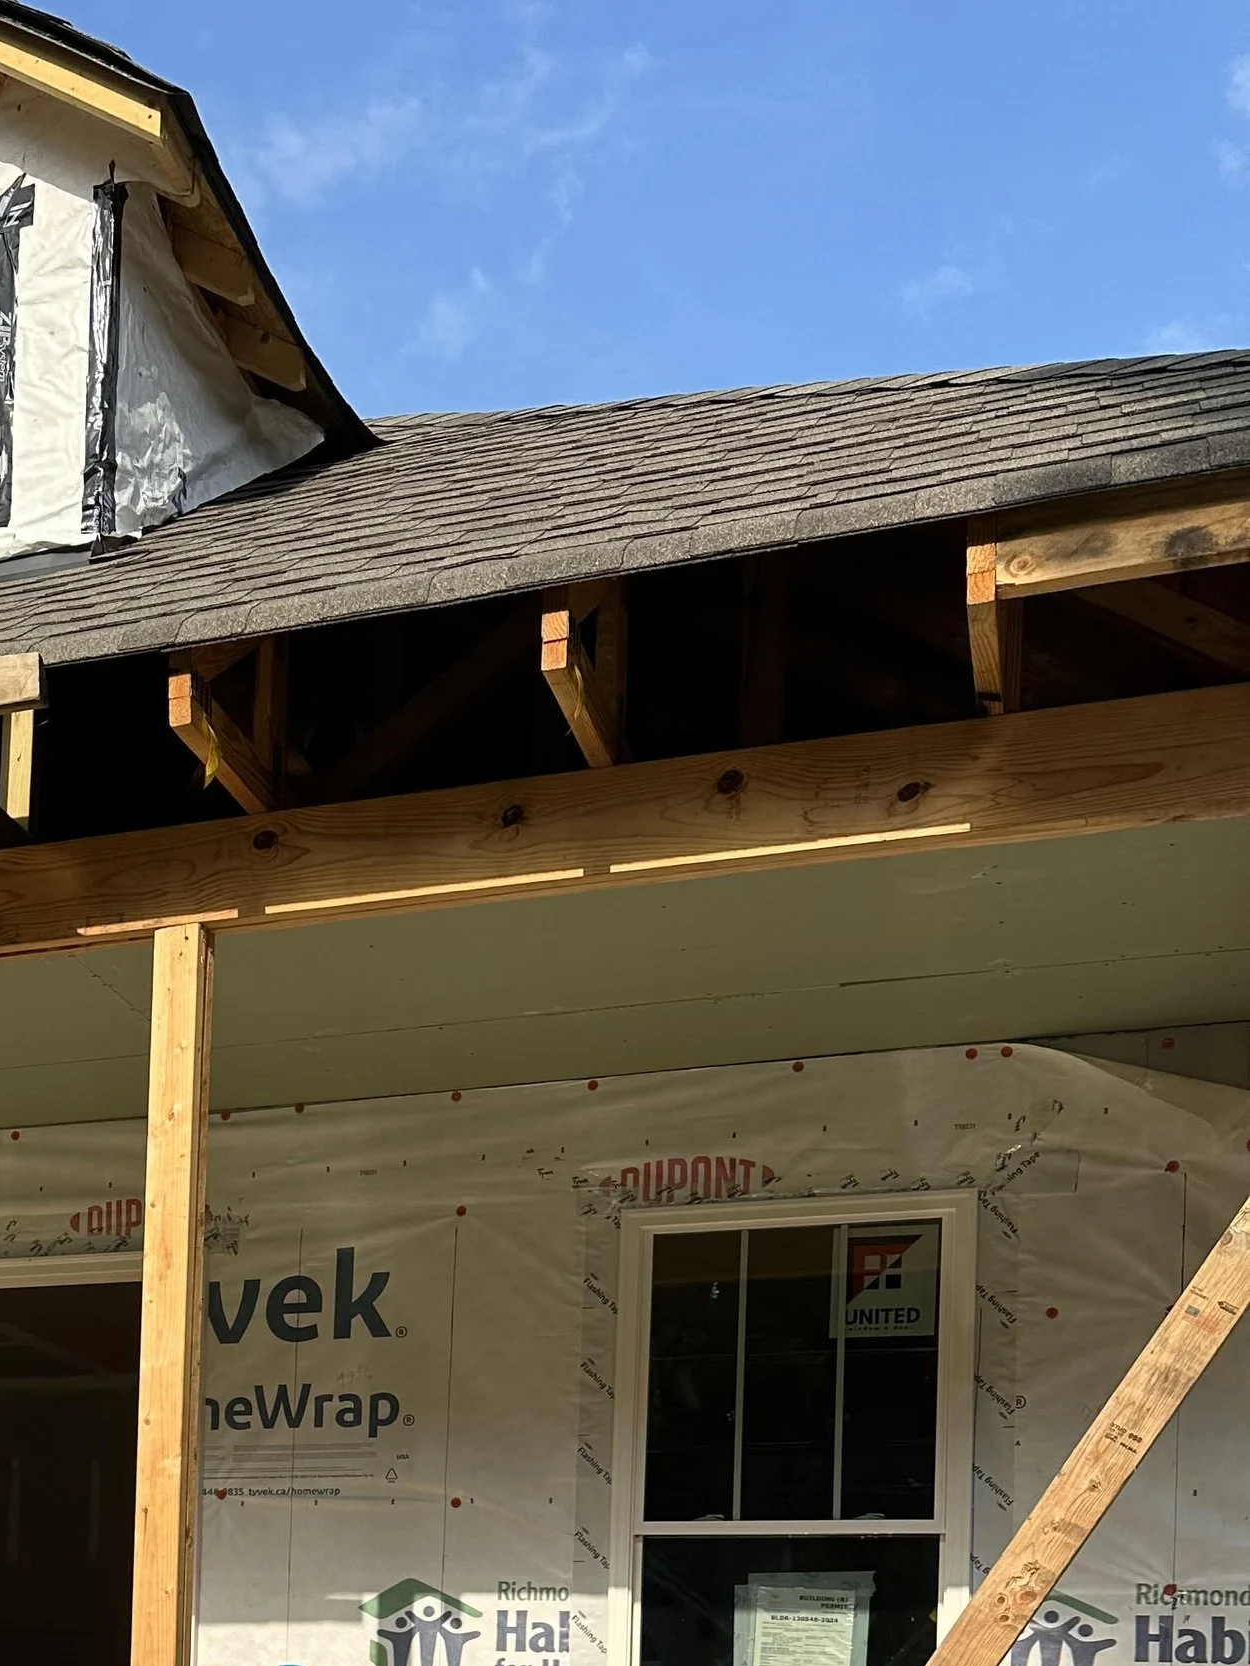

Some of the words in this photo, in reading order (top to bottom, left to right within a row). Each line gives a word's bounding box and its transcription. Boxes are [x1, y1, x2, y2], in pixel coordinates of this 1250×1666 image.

[620, 1155, 756, 1203] DUPONT
[846, 1307, 921, 1325] UNITED
[248, 1485, 342, 1499] tyvek.ca/homewrap
[574, 1530, 601, 1560] Flashing
[497, 1580, 570, 1602] Richmo
[570, 1614, 597, 1643] Flashing
